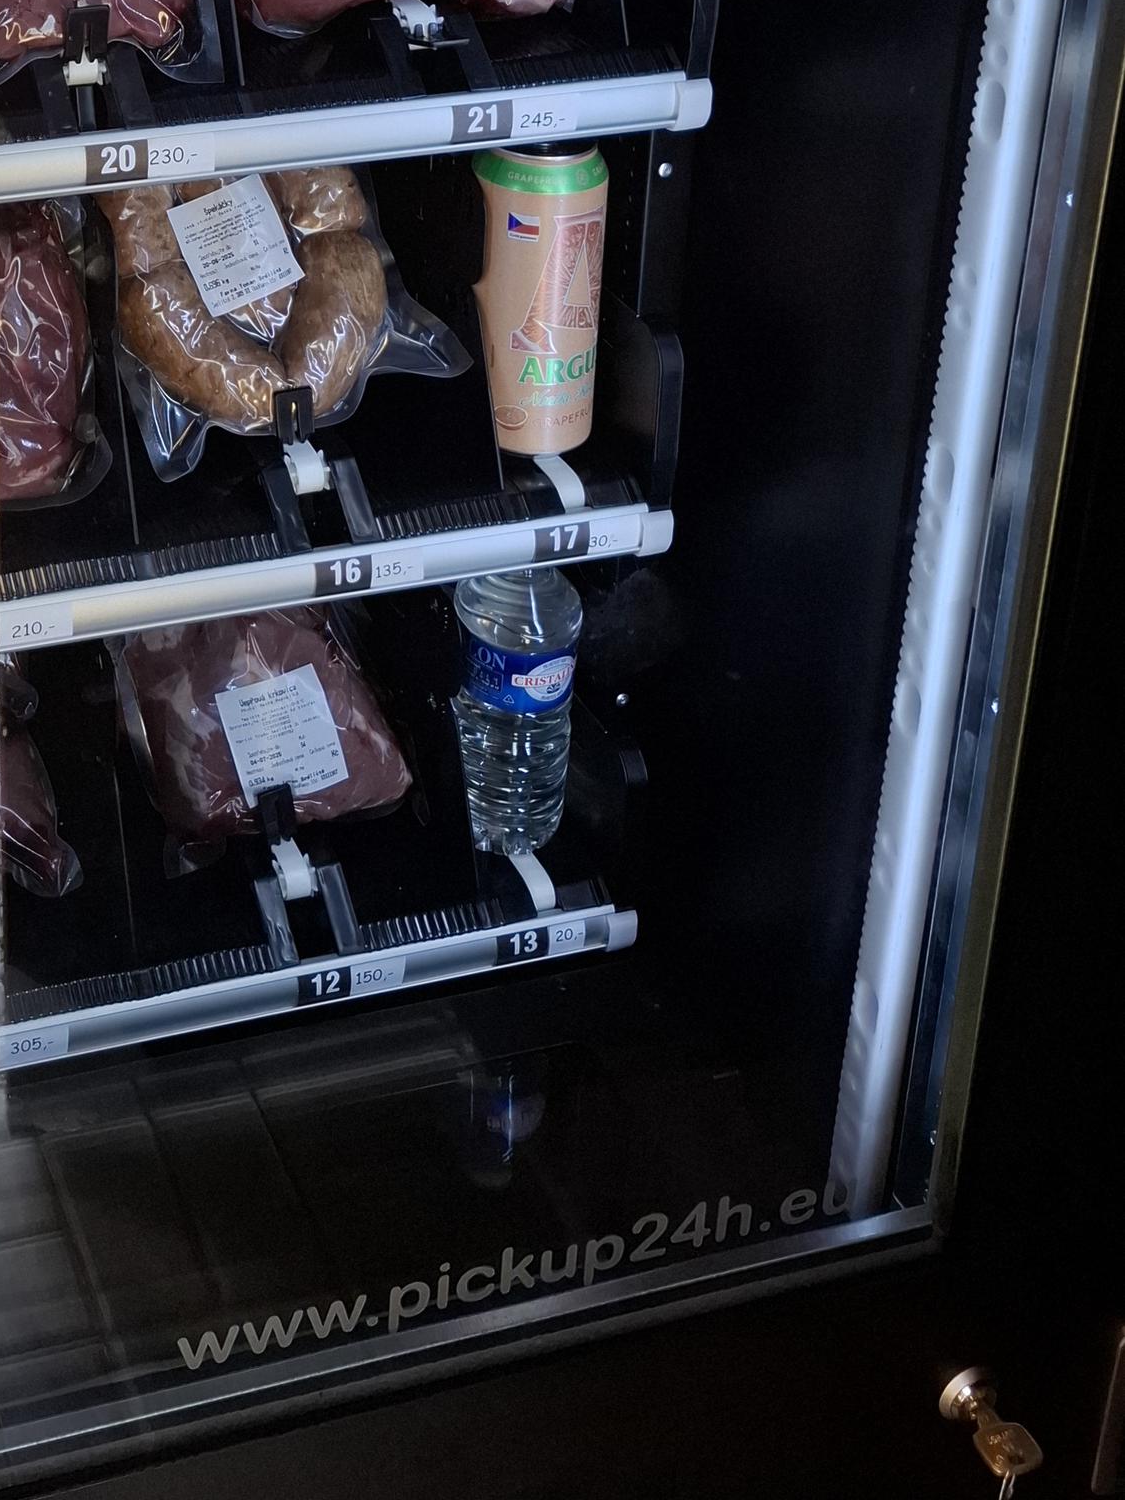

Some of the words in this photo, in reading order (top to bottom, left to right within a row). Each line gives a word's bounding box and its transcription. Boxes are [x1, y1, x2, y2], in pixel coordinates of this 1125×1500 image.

[467, 104, 498, 134] 21
[520, 112, 565, 129] 245,-
[101, 144, 137, 175] 20
[150, 146, 198, 165] 230,-
[549, 524, 579, 552] 17
[589, 535, 618, 548] 30,-
[330, 558, 361, 586] 16
[375, 561, 414, 579] 135,-
[12, 621, 56, 639] 210,-
[510, 930, 538, 956] 13
[556, 928, 583, 942] 20,-
[311, 970, 340, 996] 12
[356, 969, 394, 985] 150,-
[11, 1037, 54, 1055] 305,-
[177, 1180, 855, 1369] www.pickup24h.eu
